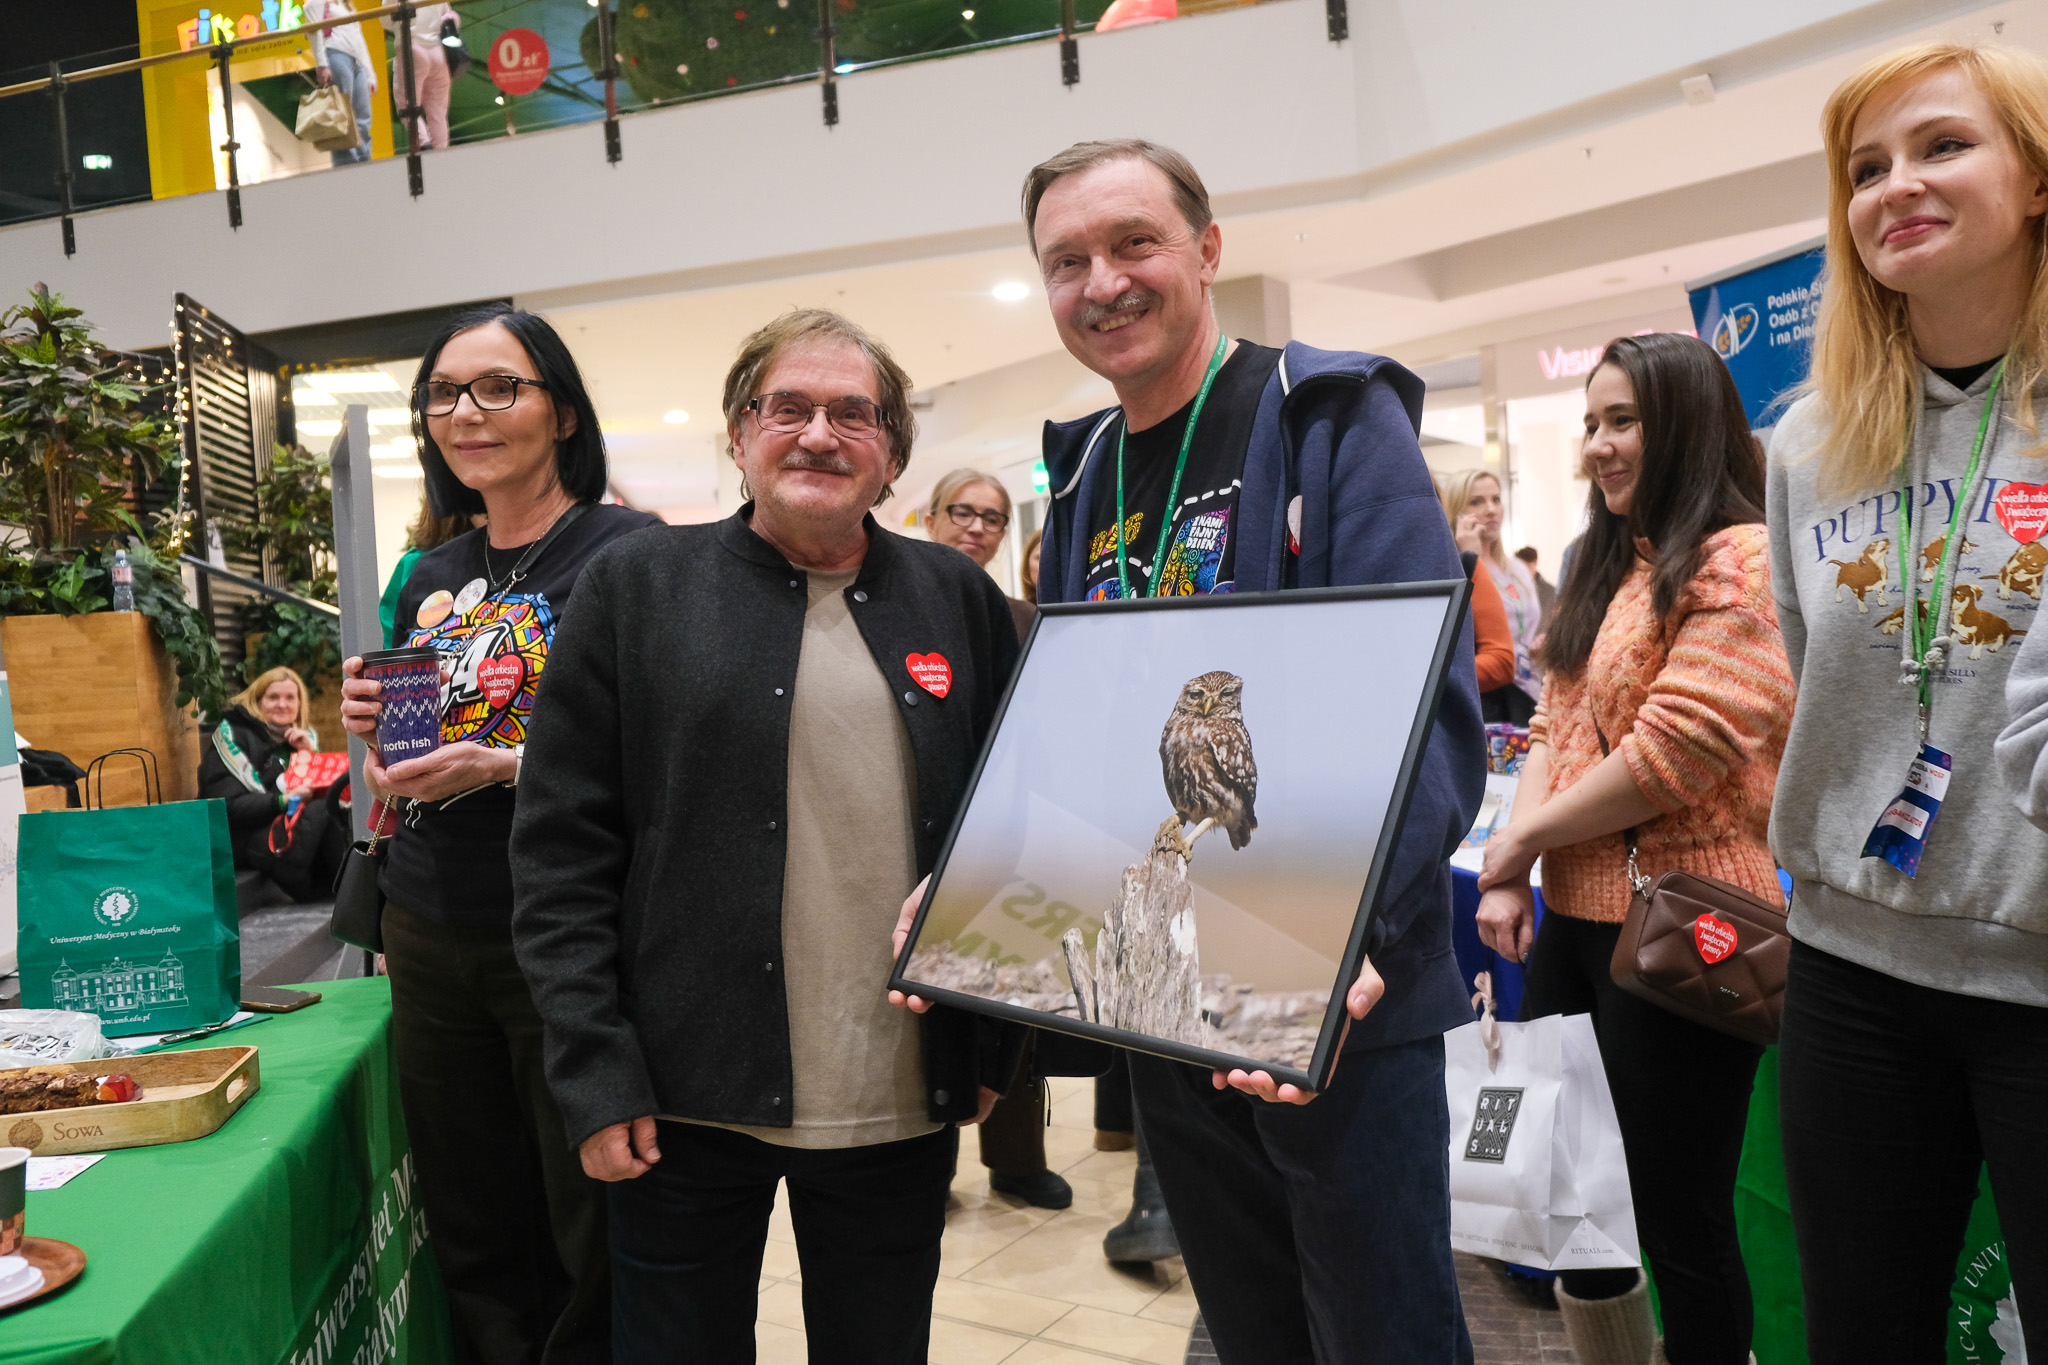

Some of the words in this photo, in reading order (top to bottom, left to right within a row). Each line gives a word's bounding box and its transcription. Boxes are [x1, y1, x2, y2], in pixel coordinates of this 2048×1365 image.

[499, 38, 520, 68] 0
[1767, 286, 1808, 310] Polskie
[1769, 308, 1799, 328] Osób
[1770, 332, 1775, 347] i
[1777, 331, 1791, 345] na
[1192, 393, 1205, 417] Medyczny
[2002, 490, 2029, 503] wielka
[1189, 527, 1220, 541] FAJNY
[2013, 520, 2044, 534] pomocy
[1150, 557, 1161, 583] Medyczny
[479, 665, 494, 678] wielka
[495, 664, 518, 675] orkiestra
[1949, 669, 1977, 678] SILLY
[484, 676, 515, 690] świątecznej
[928, 684, 947, 693] pomocy
[490, 689, 510, 700] pomocy
[384, 740, 409, 752] north
[411, 737, 430, 749] fish
[50, 934, 93, 944] Uniwersytet
[94, 931, 129, 942] Medyczny
[139, 924, 181, 936] Białymstoku
[1698, 920, 1716, 932] wielka
[1715, 927, 1735, 942] orkiestra
[1700, 930, 1730, 954] świątecznej
[1702, 943, 1723, 959] pomocy
[1964, 1240, 2006, 1288] UNIV
[290, 1190, 394, 1365] niwersytet
